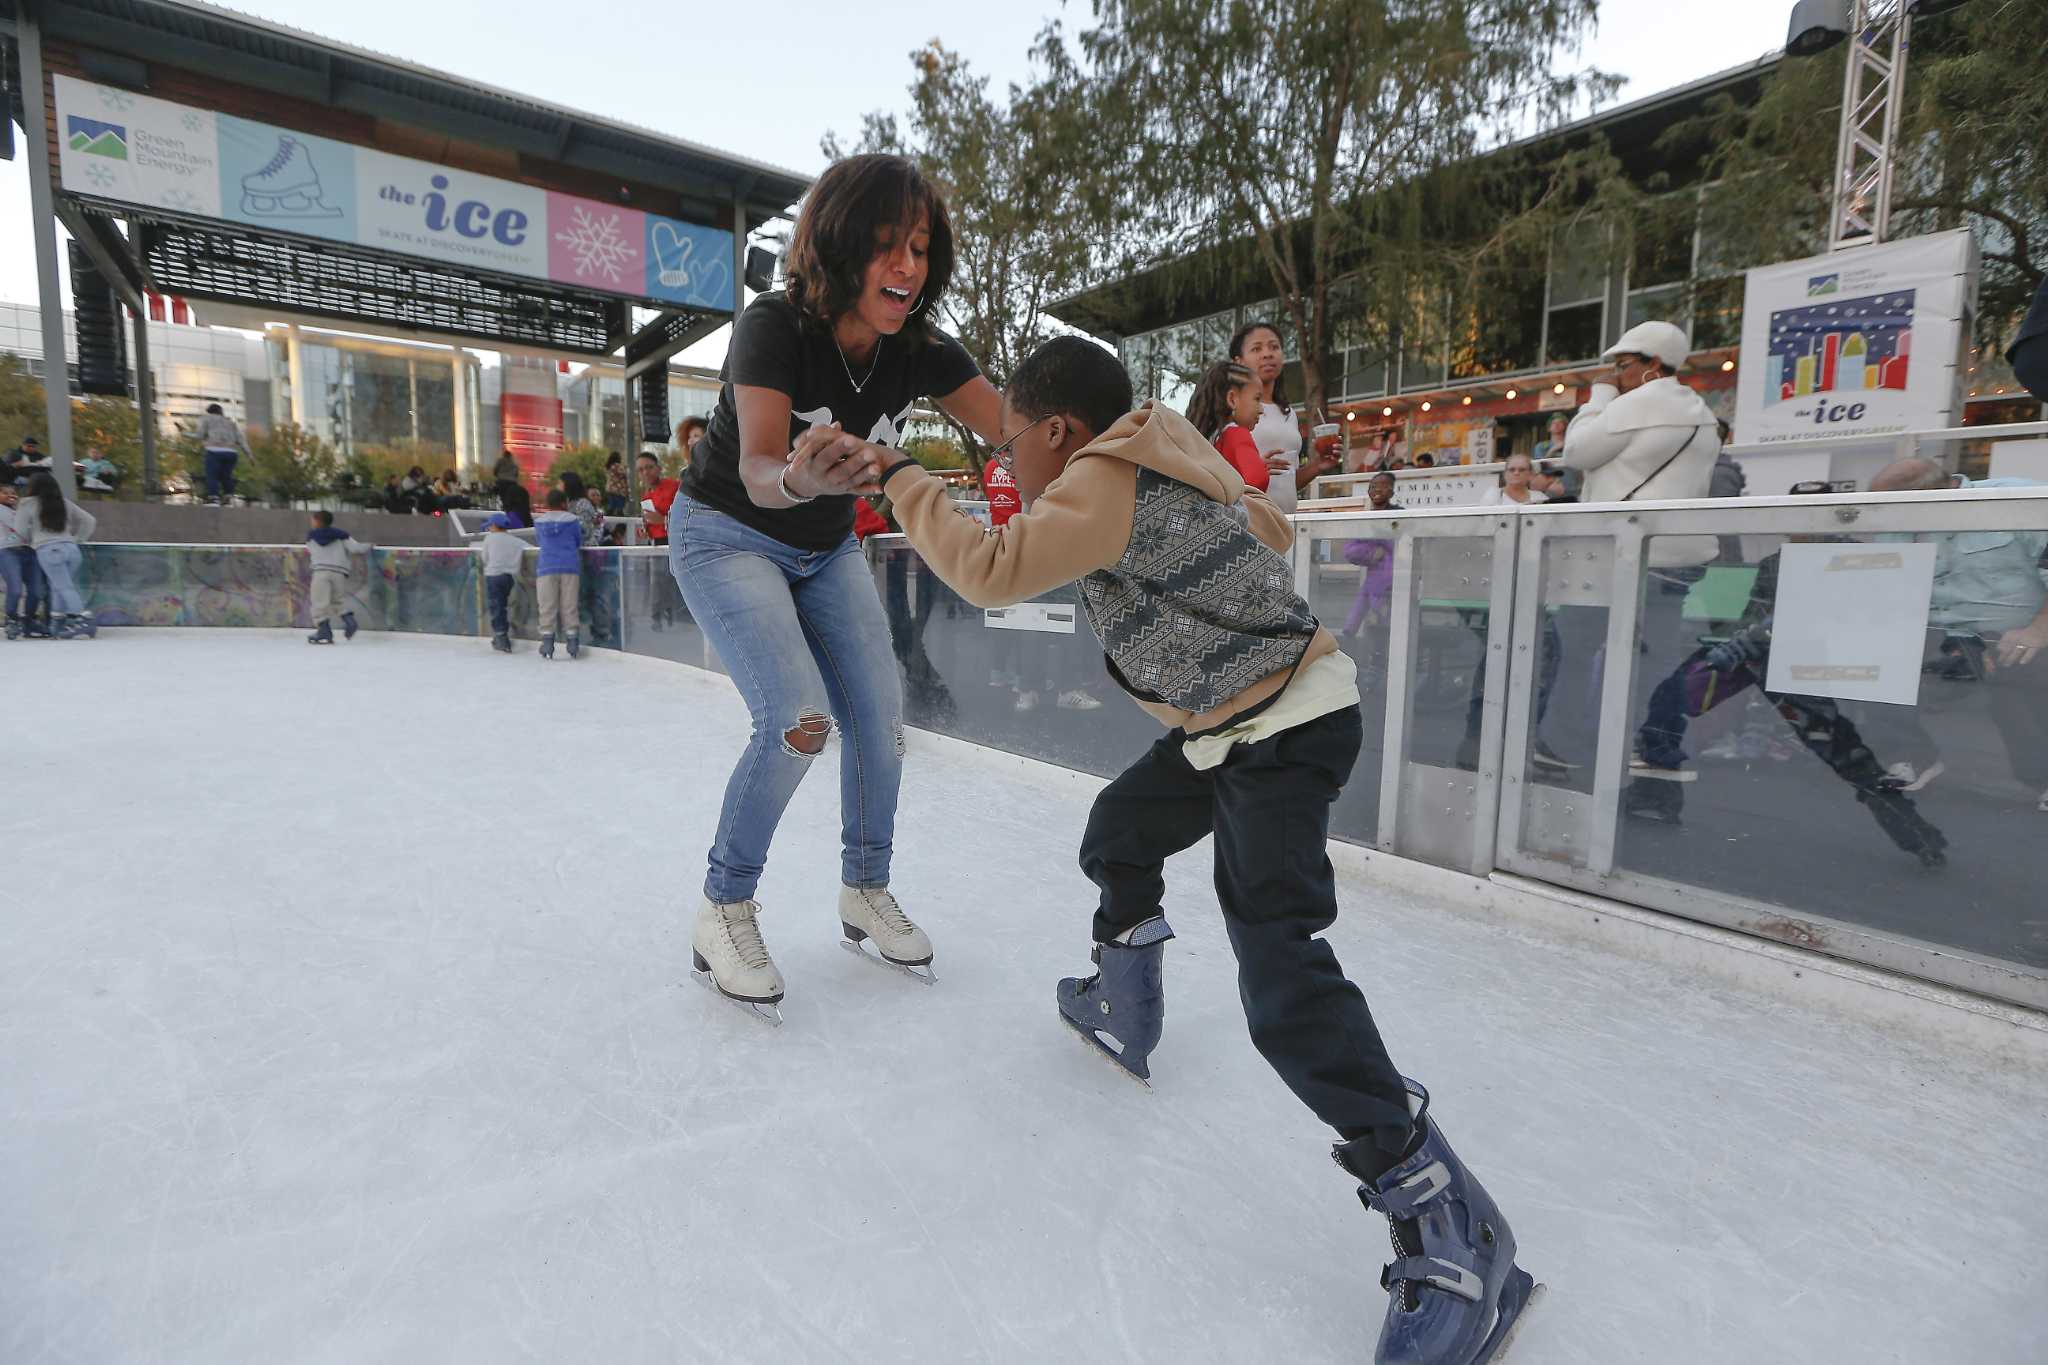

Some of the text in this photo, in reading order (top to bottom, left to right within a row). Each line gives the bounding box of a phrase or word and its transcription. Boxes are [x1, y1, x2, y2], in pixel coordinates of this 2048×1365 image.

[134, 129, 185, 150] Green
[135, 140, 214, 169] Mountain
[135, 153, 194, 177] Energy
[379, 174, 528, 246] the ice
[1814, 399, 1867, 424] ice
